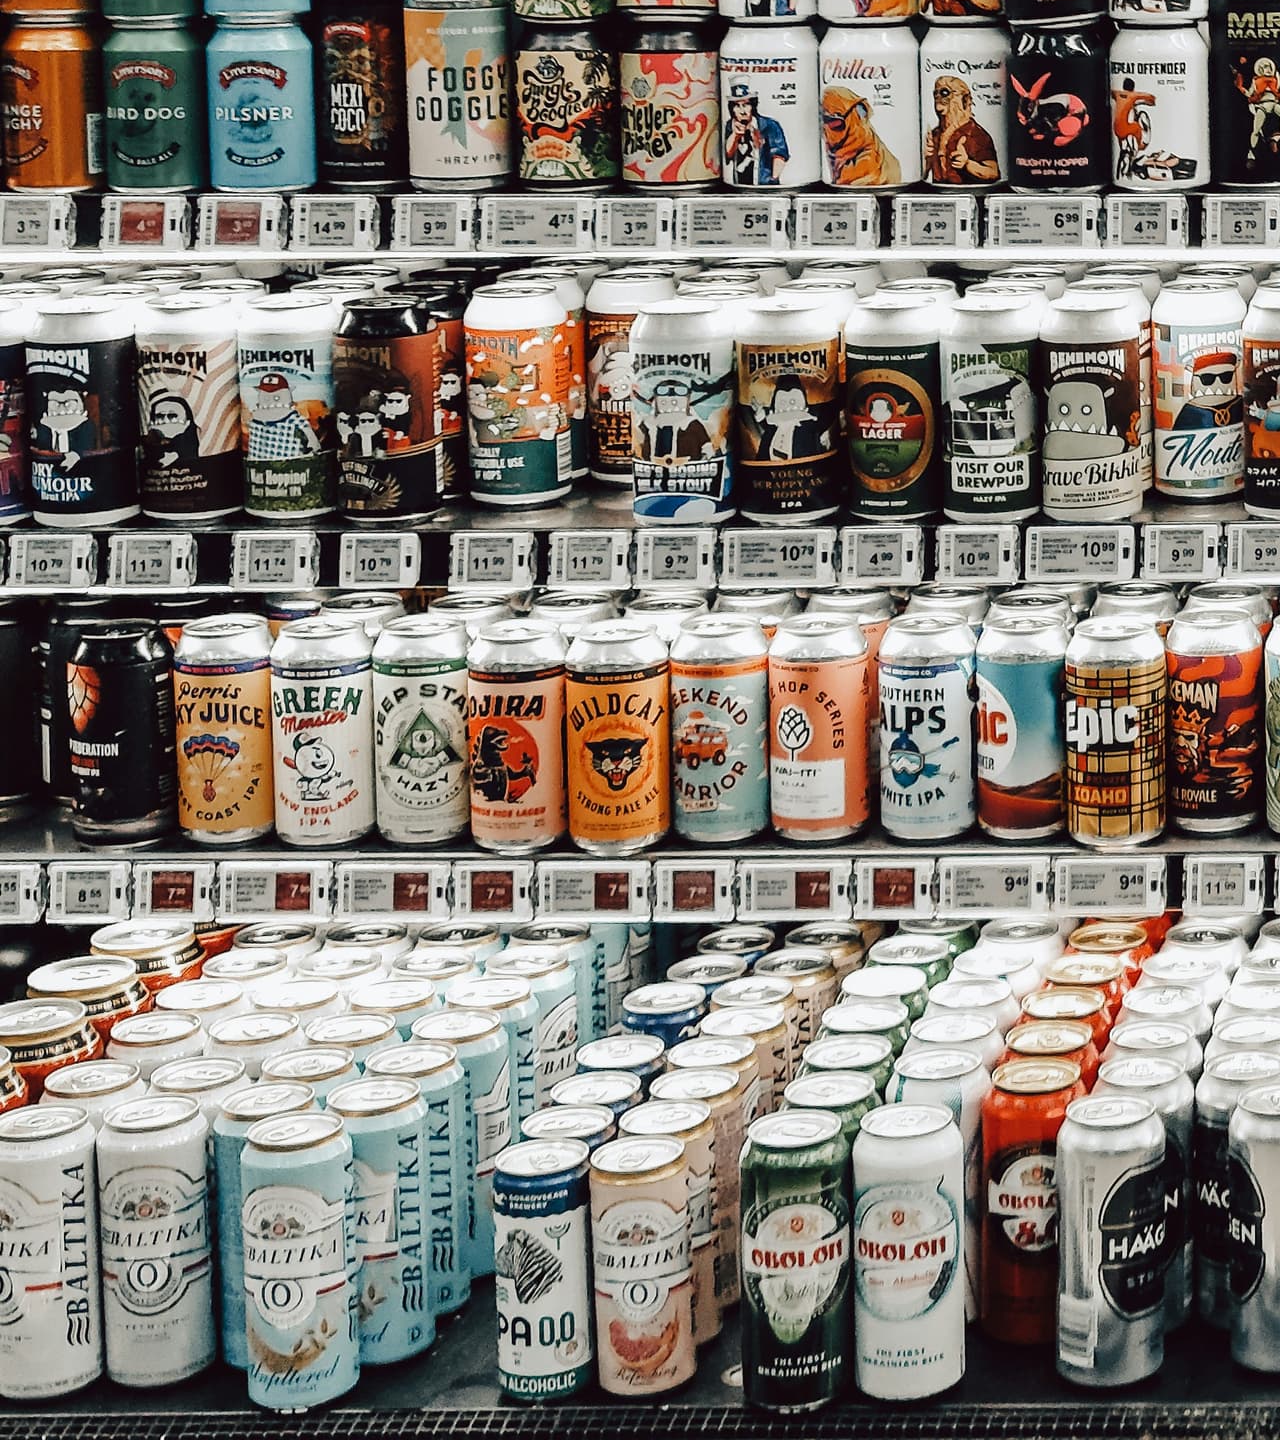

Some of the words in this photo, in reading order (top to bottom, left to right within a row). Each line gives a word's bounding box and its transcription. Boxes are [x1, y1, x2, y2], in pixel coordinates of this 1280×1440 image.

[428, 66, 507, 92] FOGGY
[1136, 61, 1187, 76] OFFENDER
[107, 107, 138, 120] BIRD
[144, 107, 186, 120] DOG
[749, 349, 828, 370] BEHEMOTH
[1050, 349, 1126, 371] BEHEMOTH
[861, 427, 903, 440] LAGER
[956, 461, 988, 476] VISIT
[994, 459, 1025, 476] OUR
[956, 474, 1025, 489] BREWPUB
[178, 681, 242, 701] Perris
[274, 687, 364, 717] GREEN
[202, 707, 266, 730] JUICE
[281, 711, 348, 732] Monster
[571, 692, 666, 730] WILDCAT
[879, 704, 947, 734] ALPS
[1066, 699, 1141, 752] Epic
[400, 1132, 420, 1283] BALTIKA
[65, 1162, 86, 1317] BALTIKA
[107, 1220, 204, 1247] BALTIKA
[248, 1240, 340, 1265] BALTIKA
[751, 1241, 844, 1269] OBOLON
[857, 1236, 947, 1261] OBOLON
[250, 1356, 340, 1392] Unfiltered
[509, 1371, 577, 1396] ALCOHOLIC
